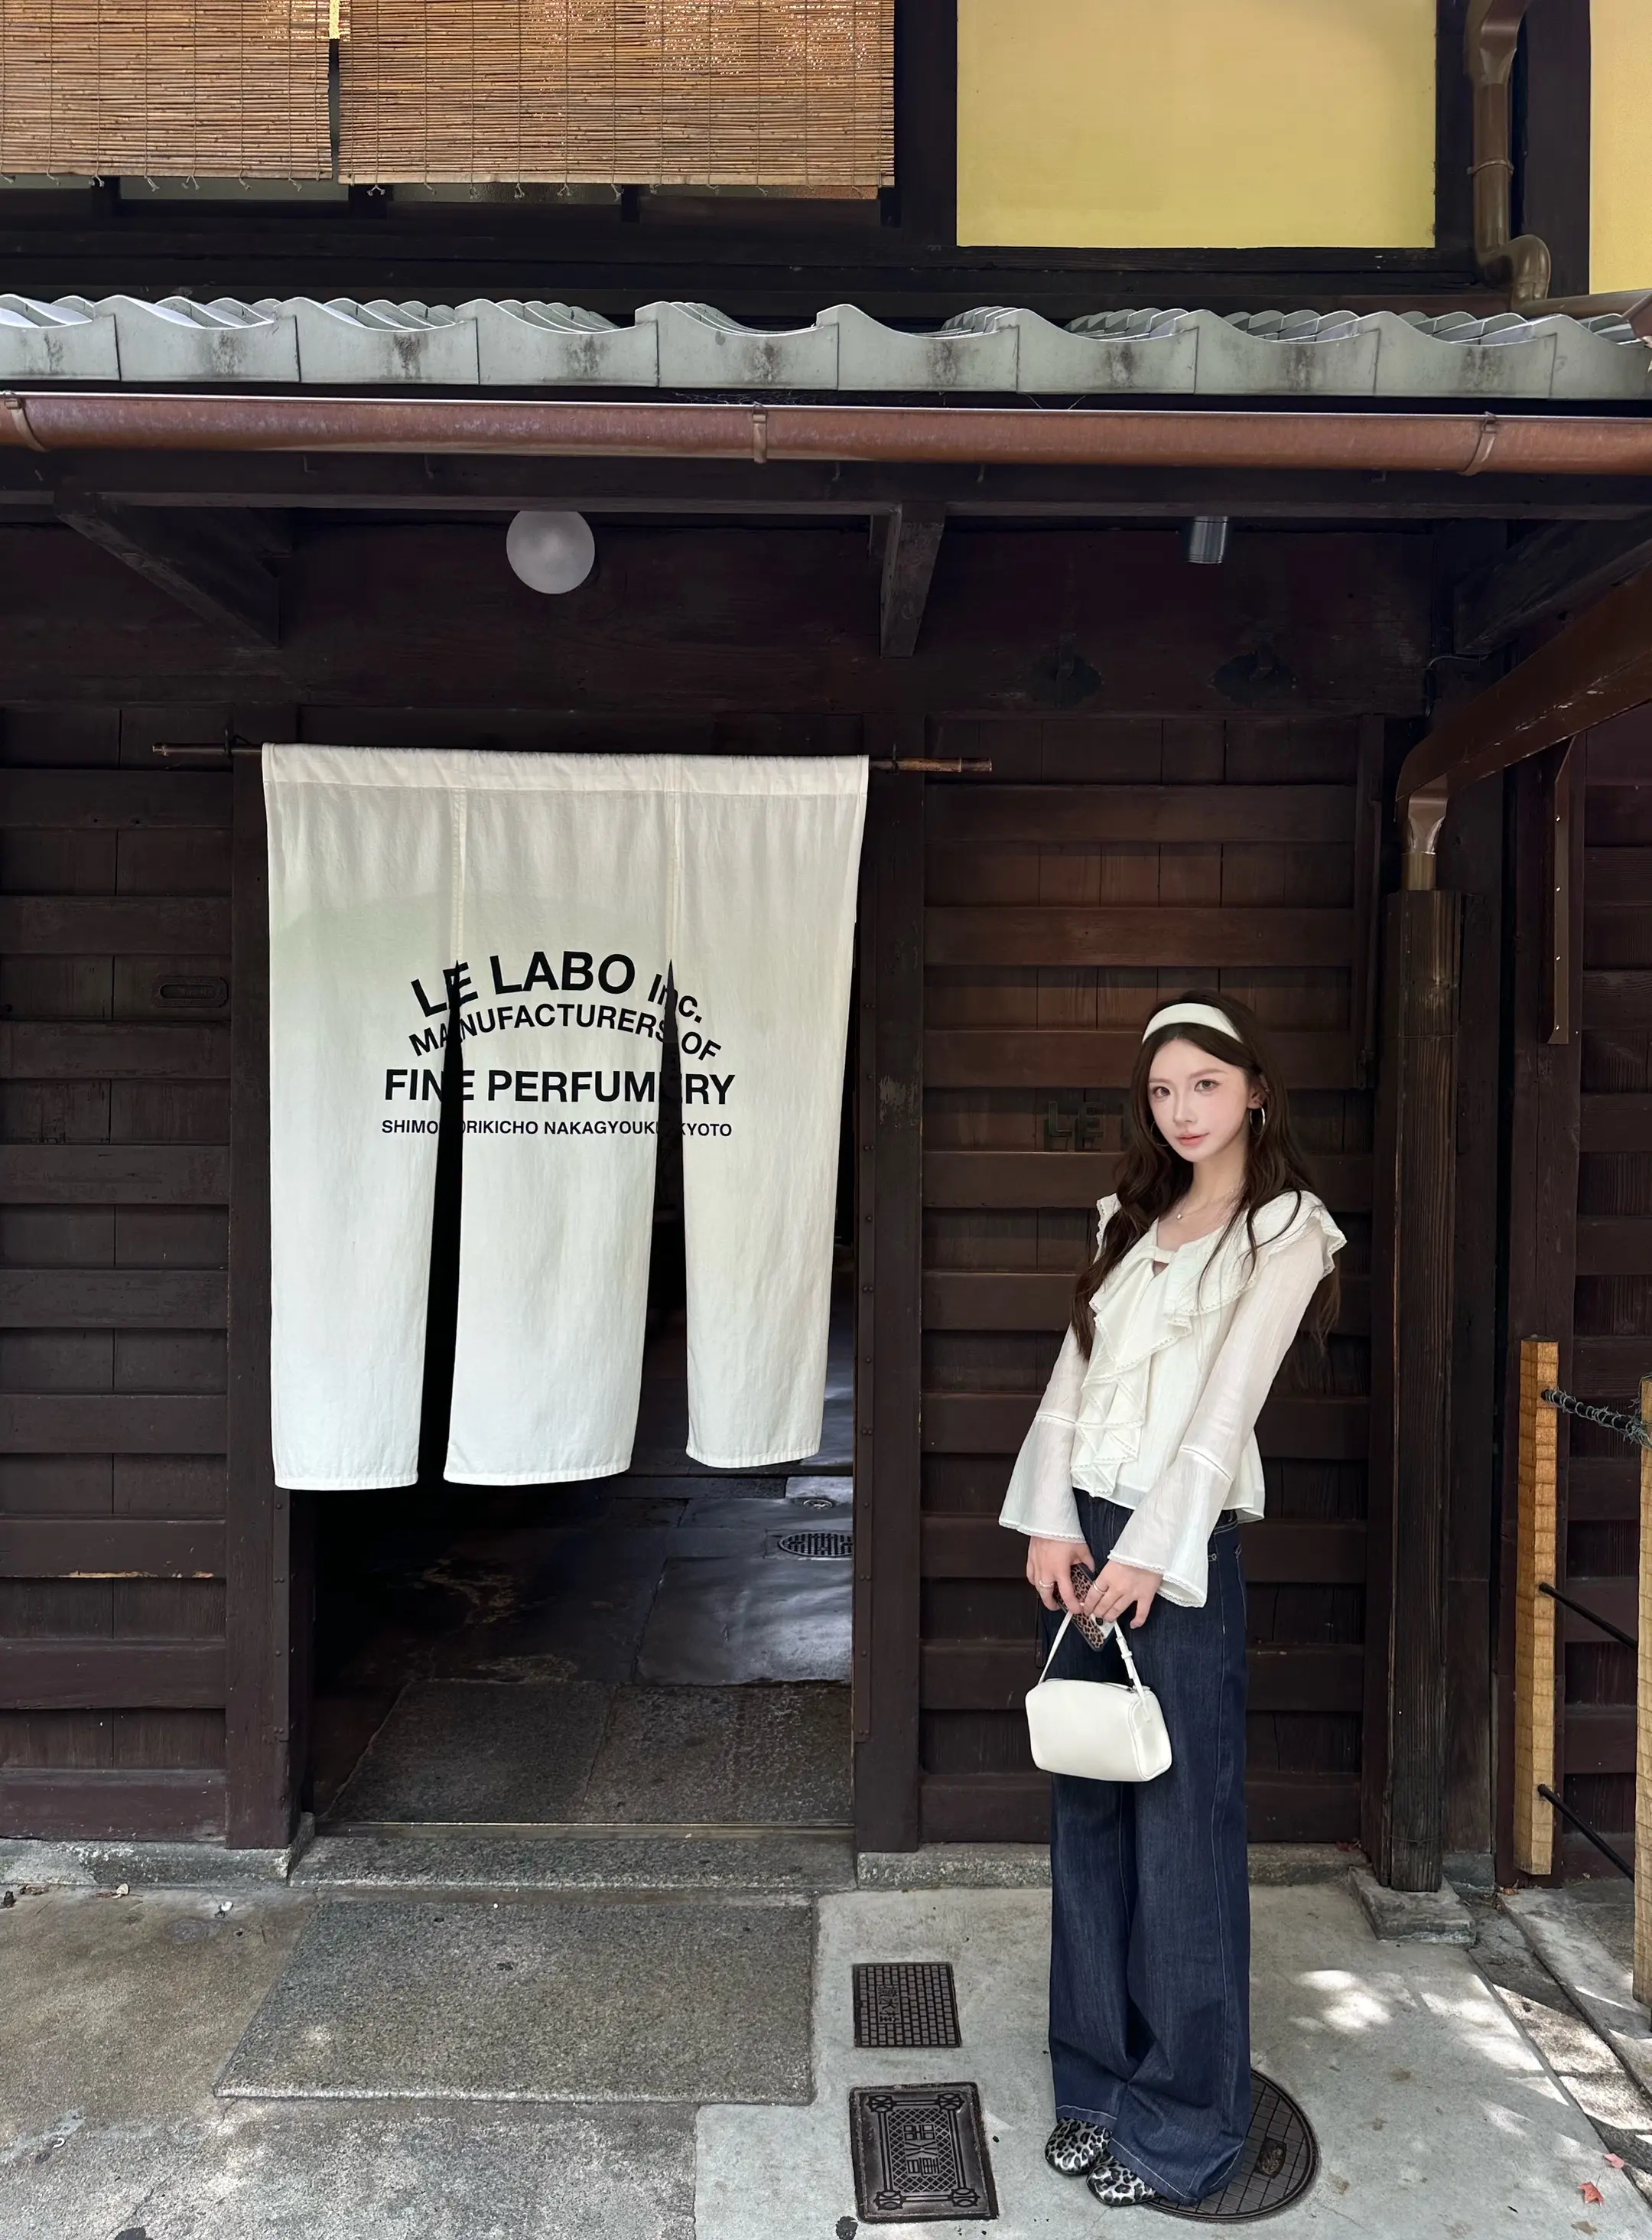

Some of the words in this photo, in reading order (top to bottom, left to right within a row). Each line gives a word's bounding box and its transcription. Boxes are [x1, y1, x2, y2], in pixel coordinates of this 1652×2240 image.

[411, 962, 479, 1017] LE
[490, 951, 636, 995] LABO
[648, 974, 702, 1024] Inc.
[681, 1031, 721, 1061] OF
[488, 1070, 736, 1105] PERFUMRY
[544, 1121, 659, 1135] NAKAGYOUK
[904, 2124, 940, 2175] 量水器
